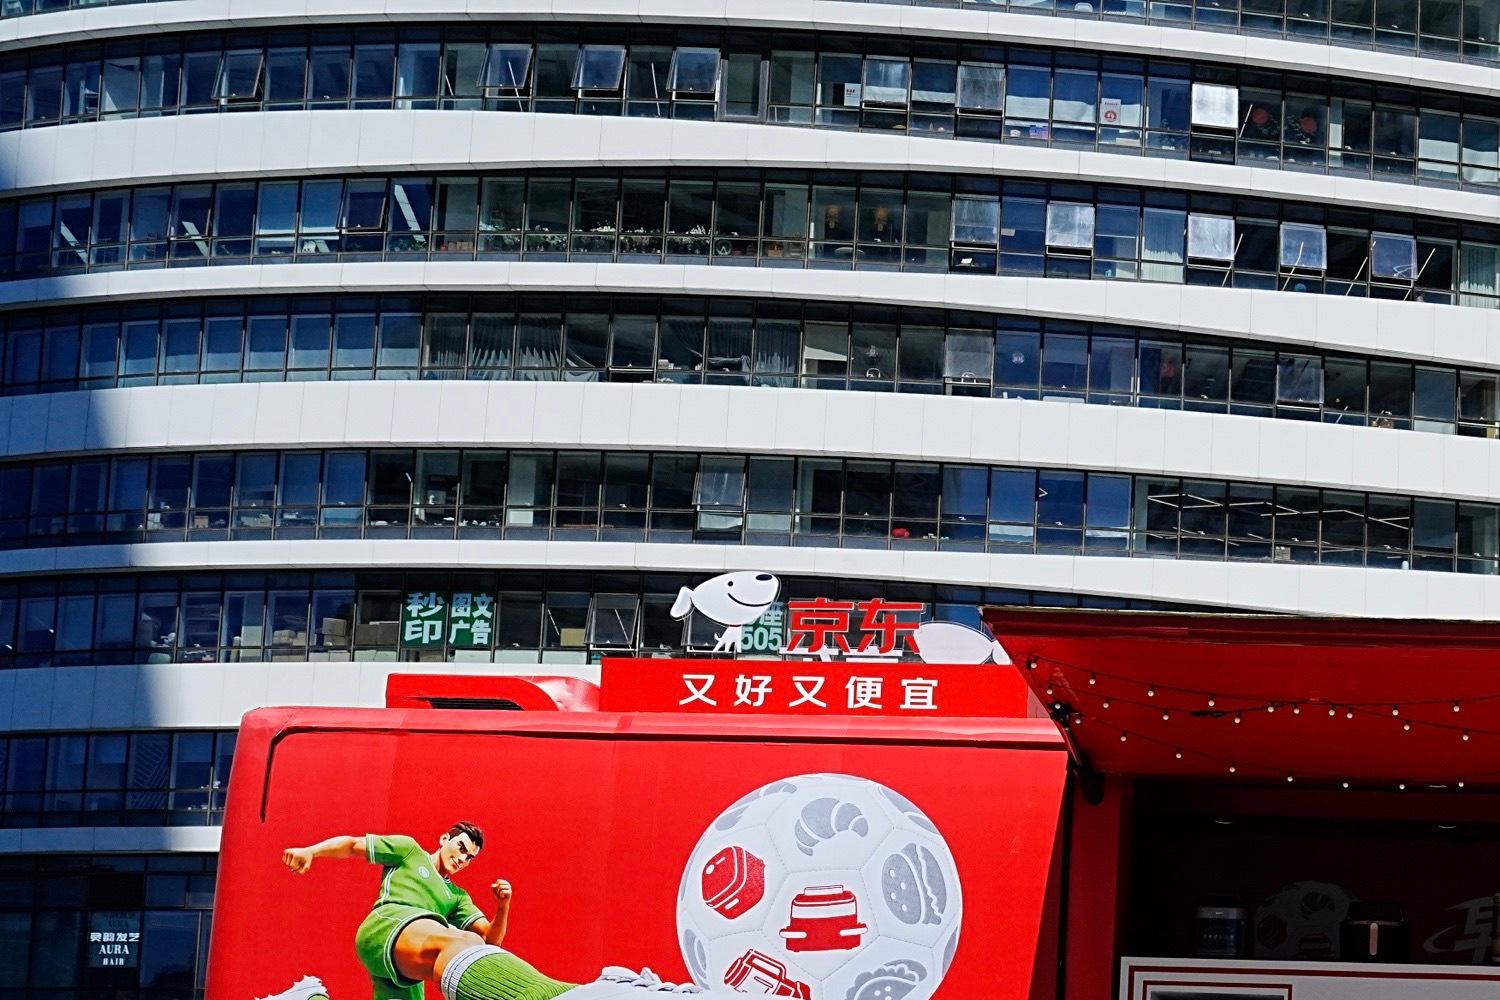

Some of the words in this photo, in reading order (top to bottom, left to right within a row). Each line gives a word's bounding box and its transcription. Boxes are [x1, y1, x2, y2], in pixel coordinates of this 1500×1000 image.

[448, 619, 492, 645] 广告
[786, 597, 926, 654] 京东
[741, 628, 783, 651] 505
[680, 674, 939, 710] 又好又便宜
[99, 944, 130, 955] AURA
